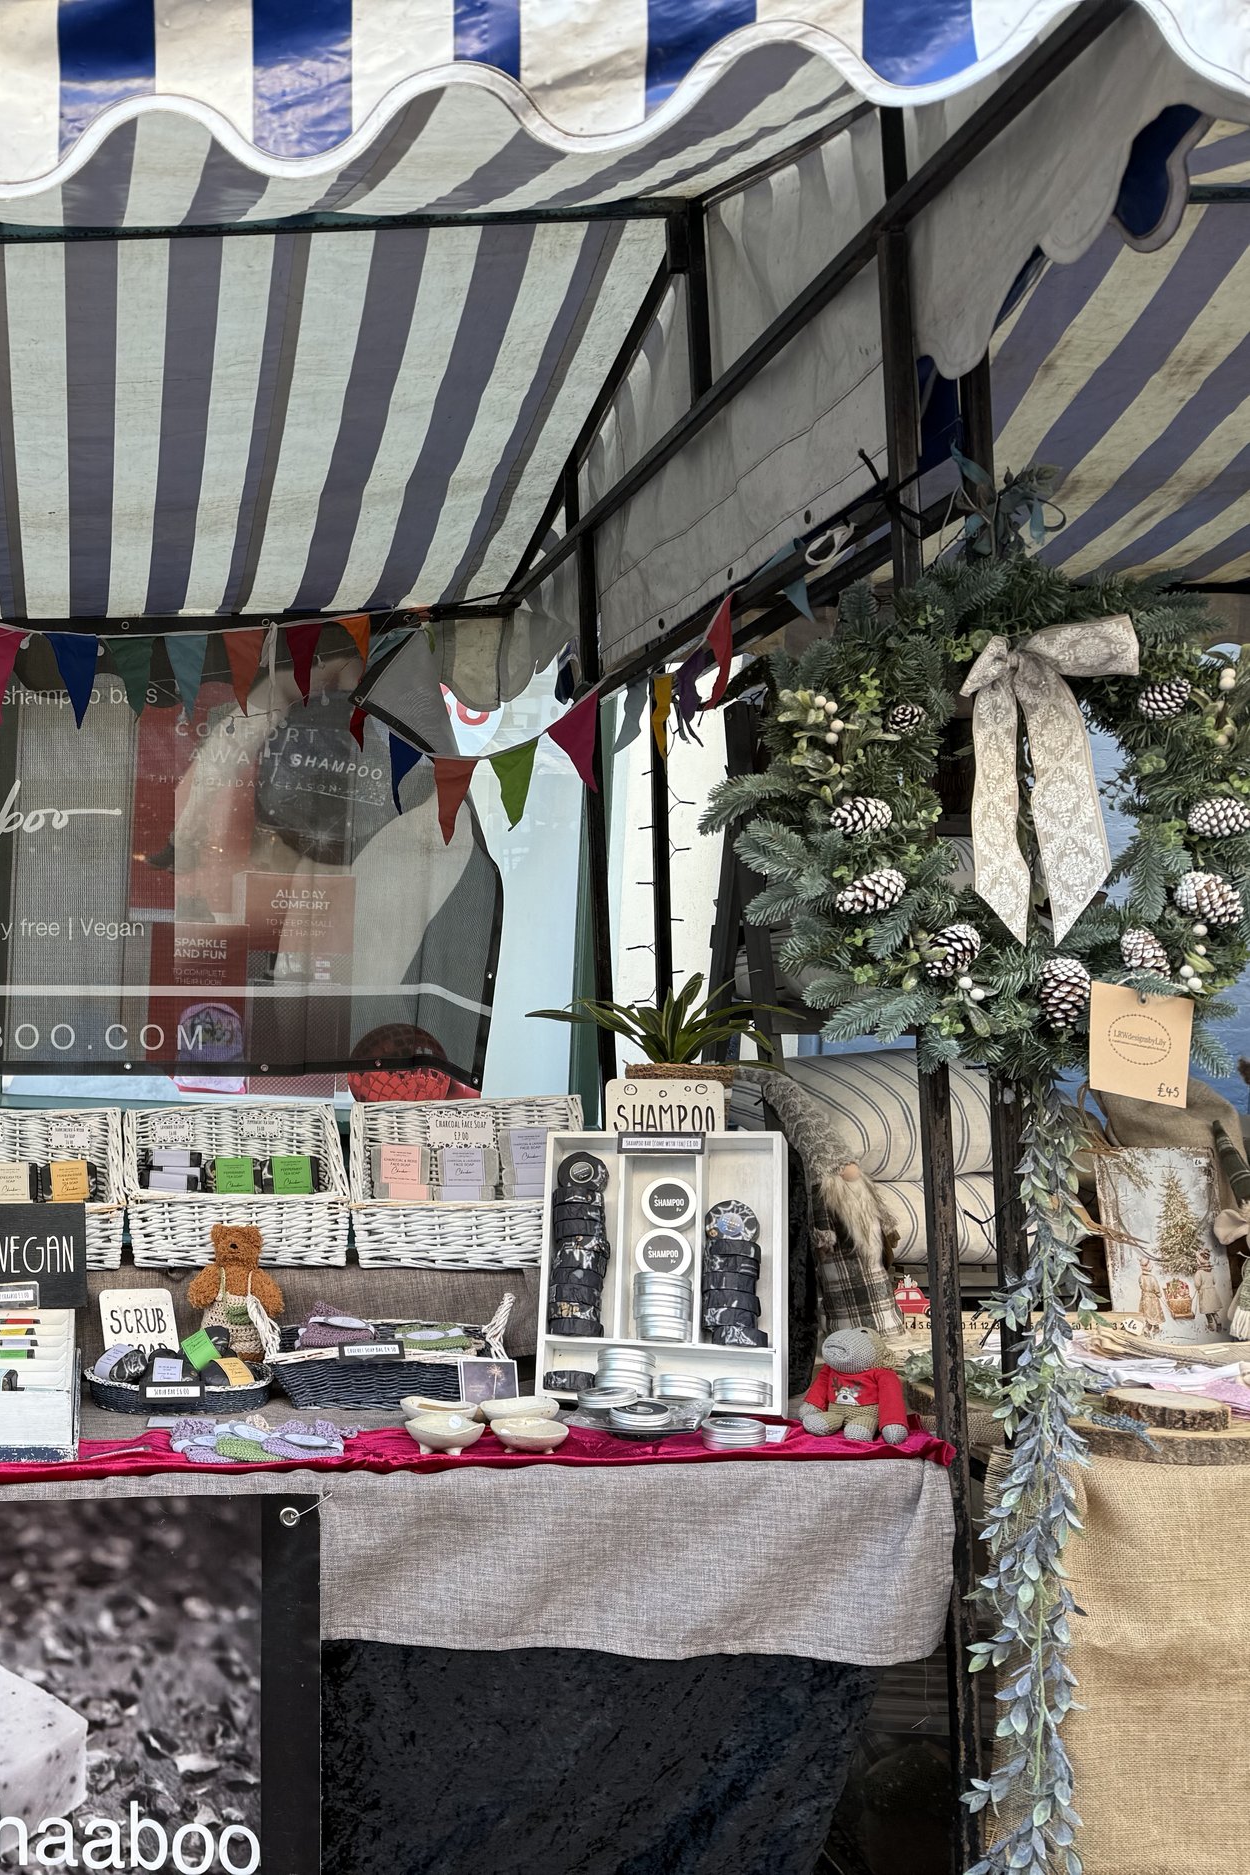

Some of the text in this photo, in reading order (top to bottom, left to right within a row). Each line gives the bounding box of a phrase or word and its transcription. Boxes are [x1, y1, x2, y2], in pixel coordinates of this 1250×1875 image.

[2, 686, 100, 709] shampo
[293, 753, 383, 781] SHAMPOO
[149, 774, 184, 785] THIS
[275, 889, 327, 900] ALL DAY
[271, 899, 331, 911] COMFORT
[20, 918, 60, 937] free
[80, 918, 145, 941] Vegan
[174, 937, 228, 949] SPARKLE
[173, 948, 227, 960] AND FUN
[1157, 1082, 1180, 1099] £45
[613, 1104, 715, 1131] SHAMPOO
[435, 1119, 486, 1129] CHARCOAL FACE SOAP
[654, 1198, 685, 1207] SHAMPOO
[648, 1250, 679, 1258] SHAMPOO
[110, 1308, 167, 1335] SCRUB
